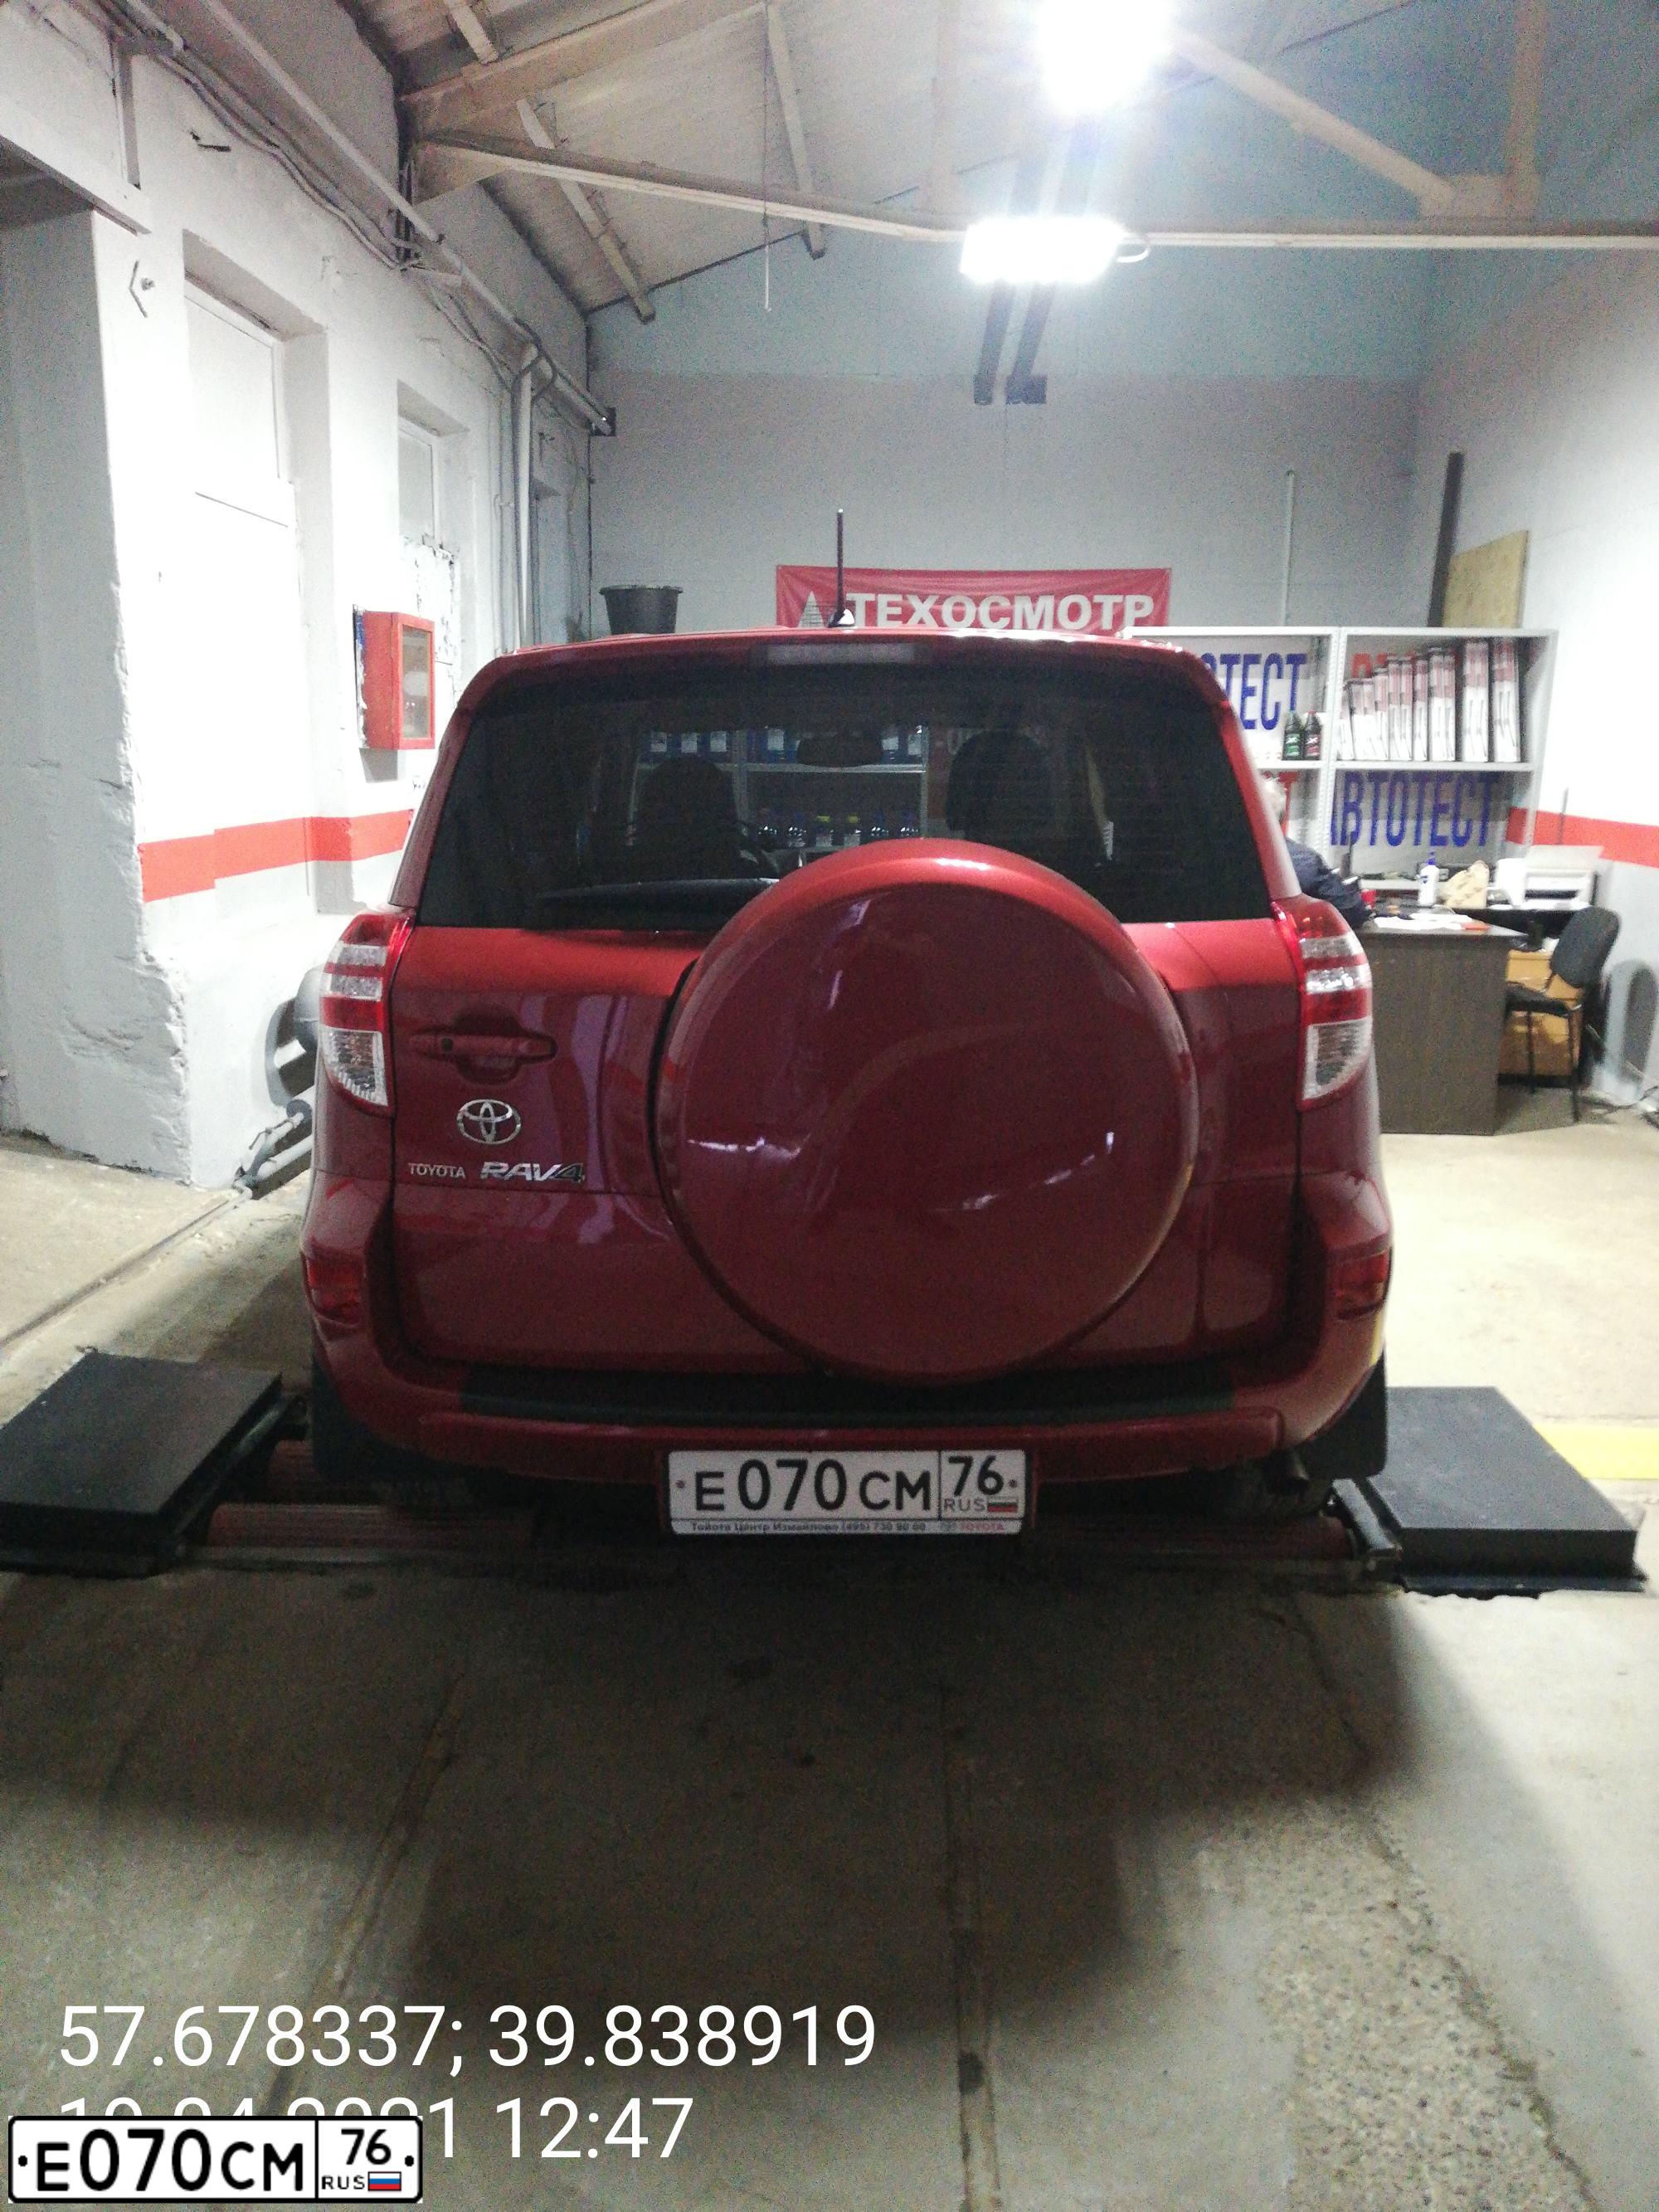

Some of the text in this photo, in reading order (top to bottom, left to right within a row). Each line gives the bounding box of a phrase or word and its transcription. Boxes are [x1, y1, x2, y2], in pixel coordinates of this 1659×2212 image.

[845, 592, 1155, 631] ТЕХОСМОТР
[1201, 652, 1308, 731] ТЕСТ
[408, 1162, 586, 1183] TOYOTA RAV4
[948, 1456, 1005, 1497] 76
[943, 1497, 985, 1513] RUS
